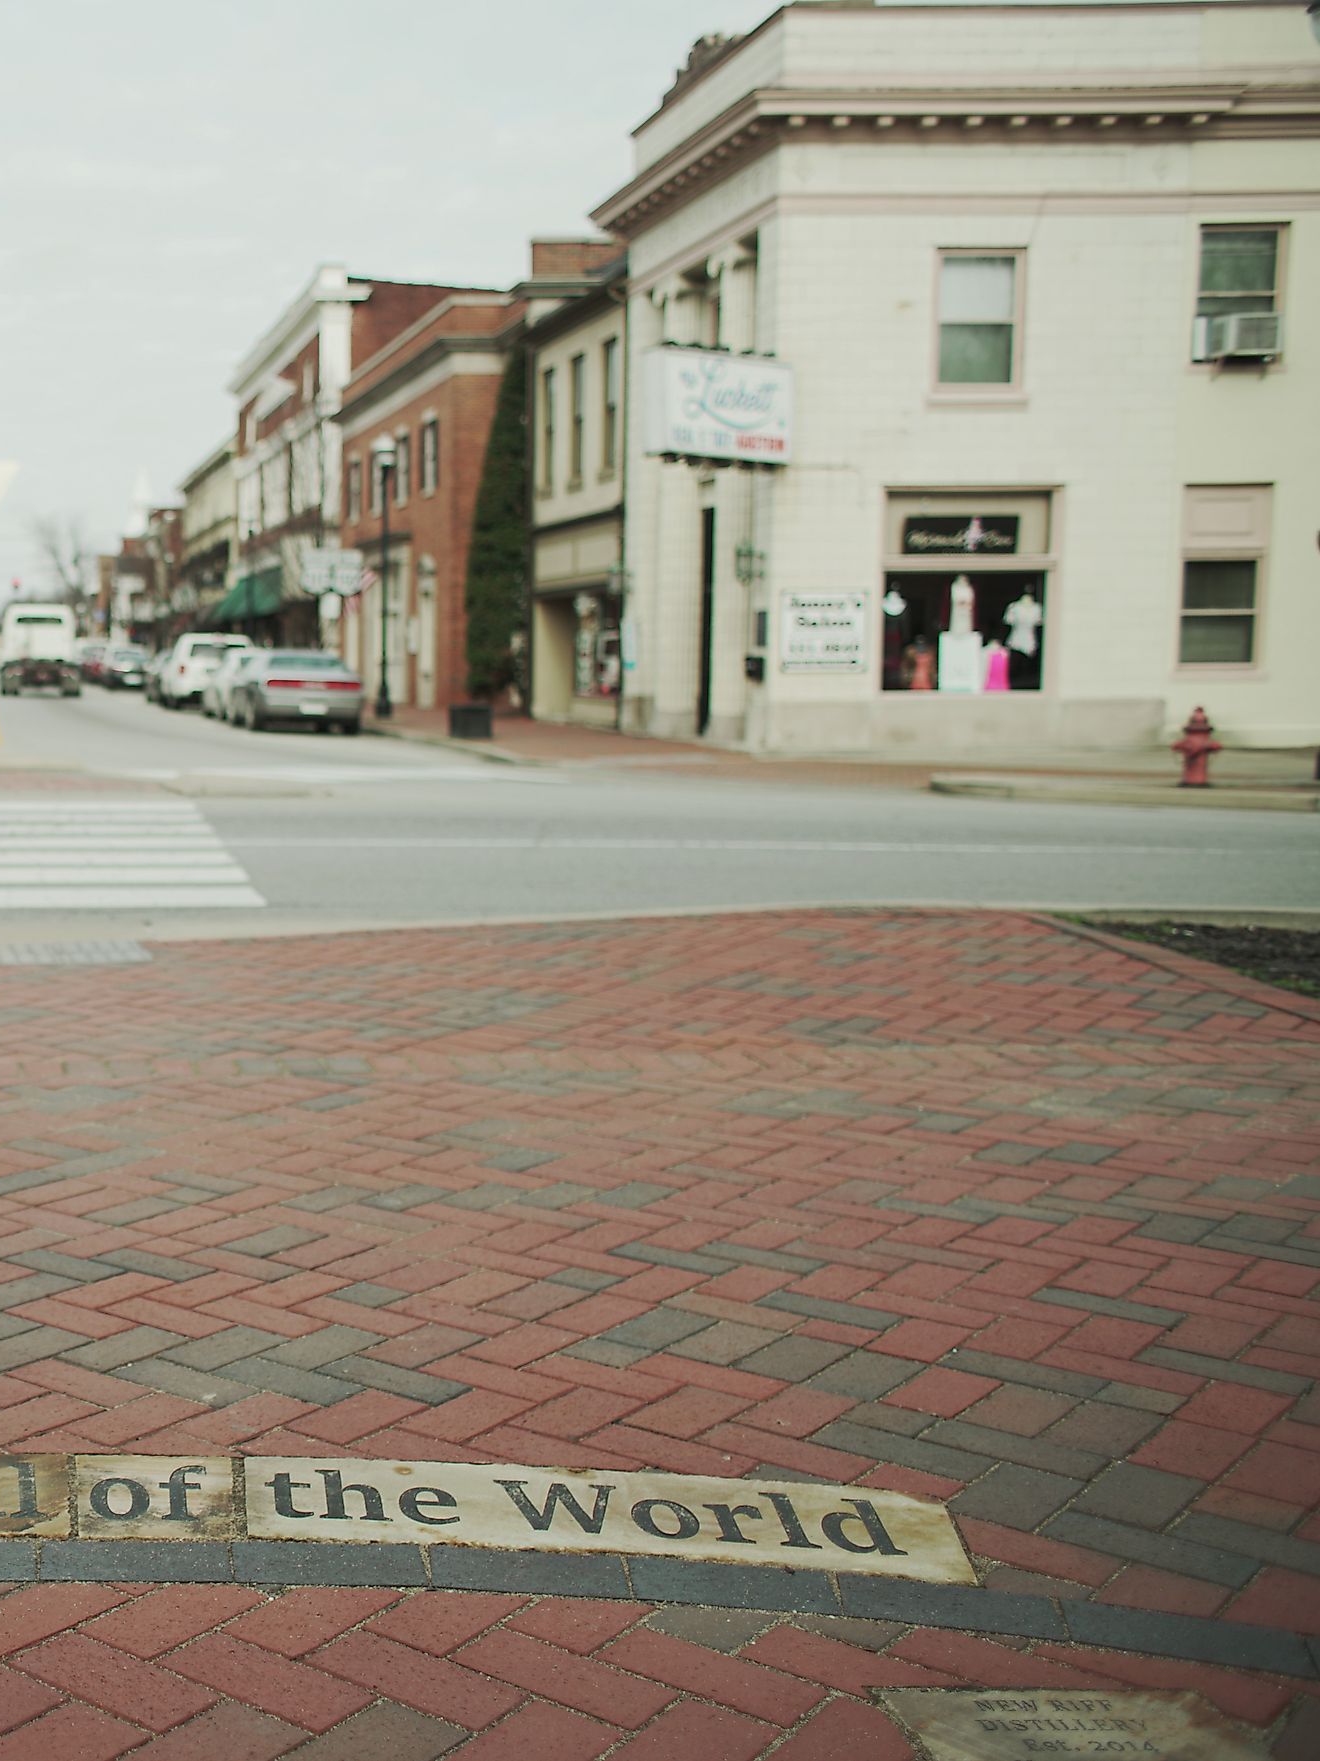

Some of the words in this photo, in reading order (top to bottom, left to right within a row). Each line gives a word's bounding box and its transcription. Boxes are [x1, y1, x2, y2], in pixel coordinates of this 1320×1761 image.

[88, 1464, 207, 1522] of
[265, 1468, 462, 1526] the
[493, 1478, 910, 1557] World
[974, 1699, 1039, 1713] NEW
[1046, 1699, 1113, 1713] RIFF
[974, 1718, 1149, 1732] DISTILLERY
